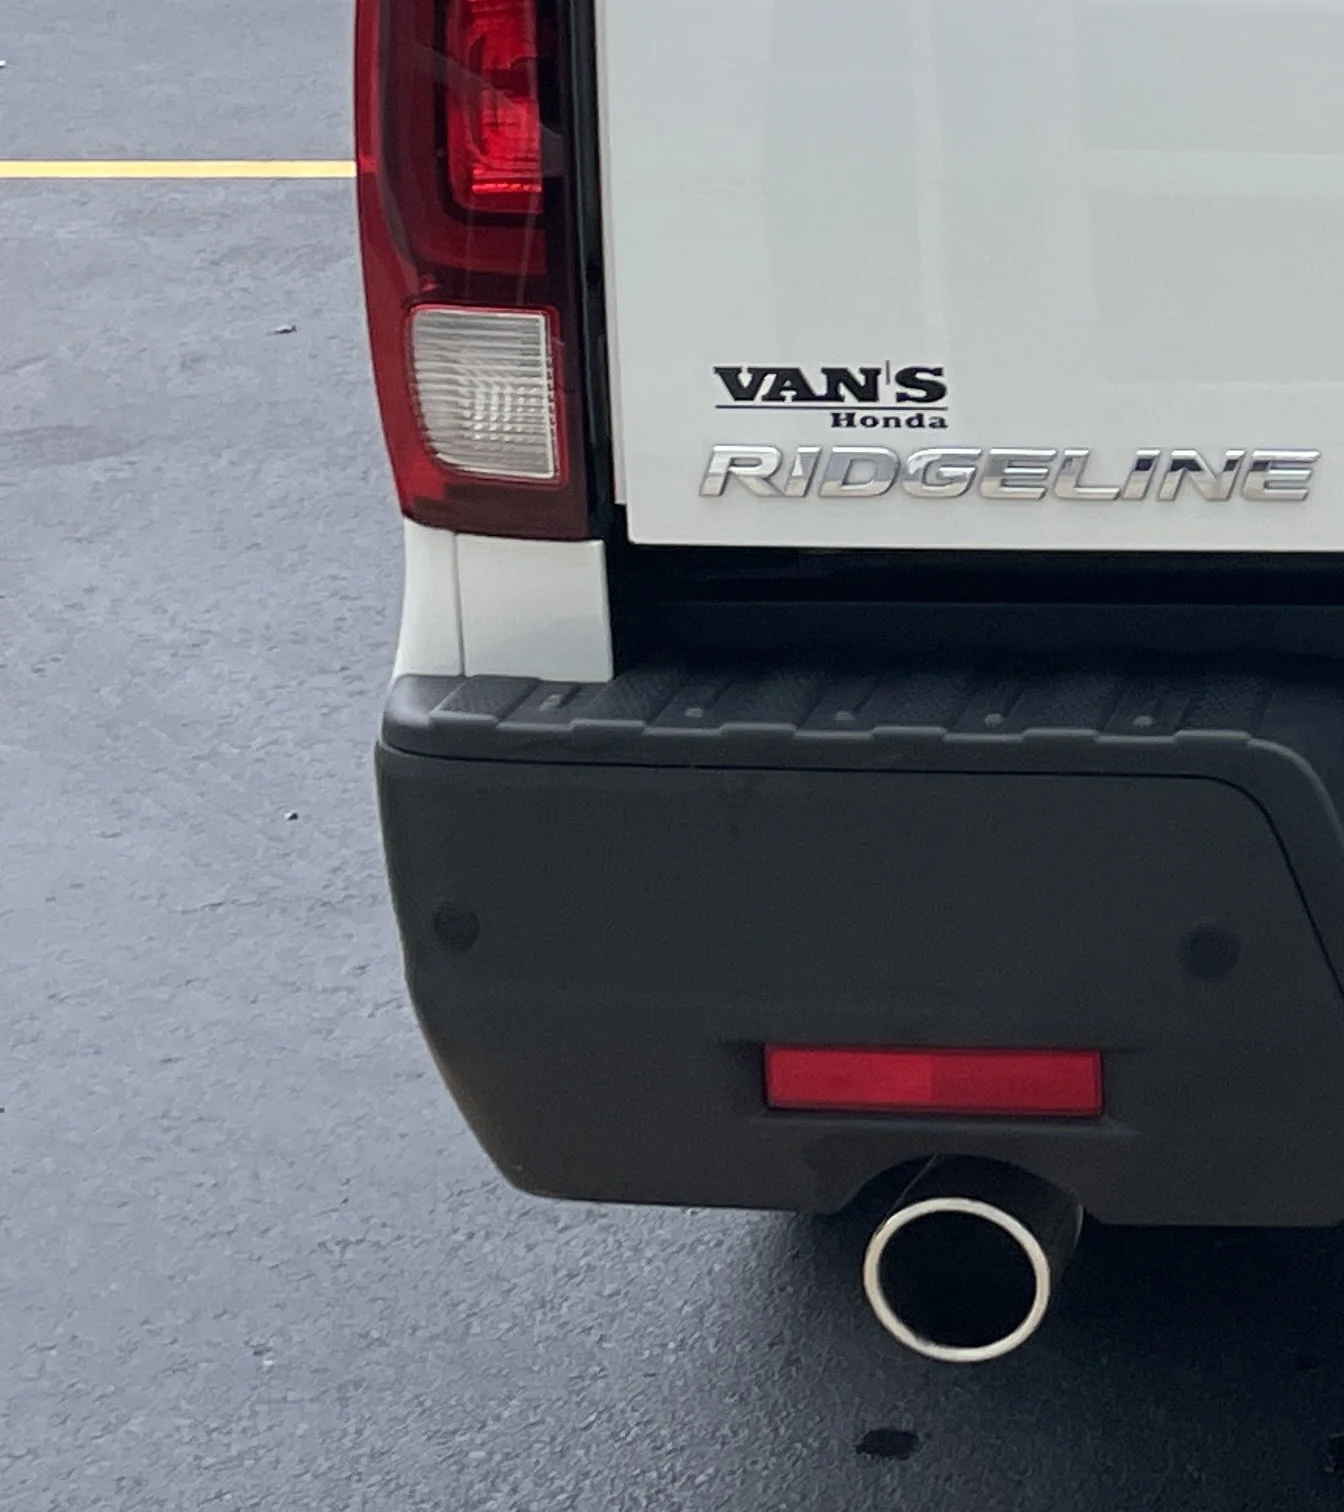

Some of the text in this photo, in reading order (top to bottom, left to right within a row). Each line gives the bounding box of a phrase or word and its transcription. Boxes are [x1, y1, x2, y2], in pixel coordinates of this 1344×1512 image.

[712, 360, 948, 403] VAN'S
[830, 412, 949, 429] Honda
[700, 444, 1321, 502] RIDGELINE
